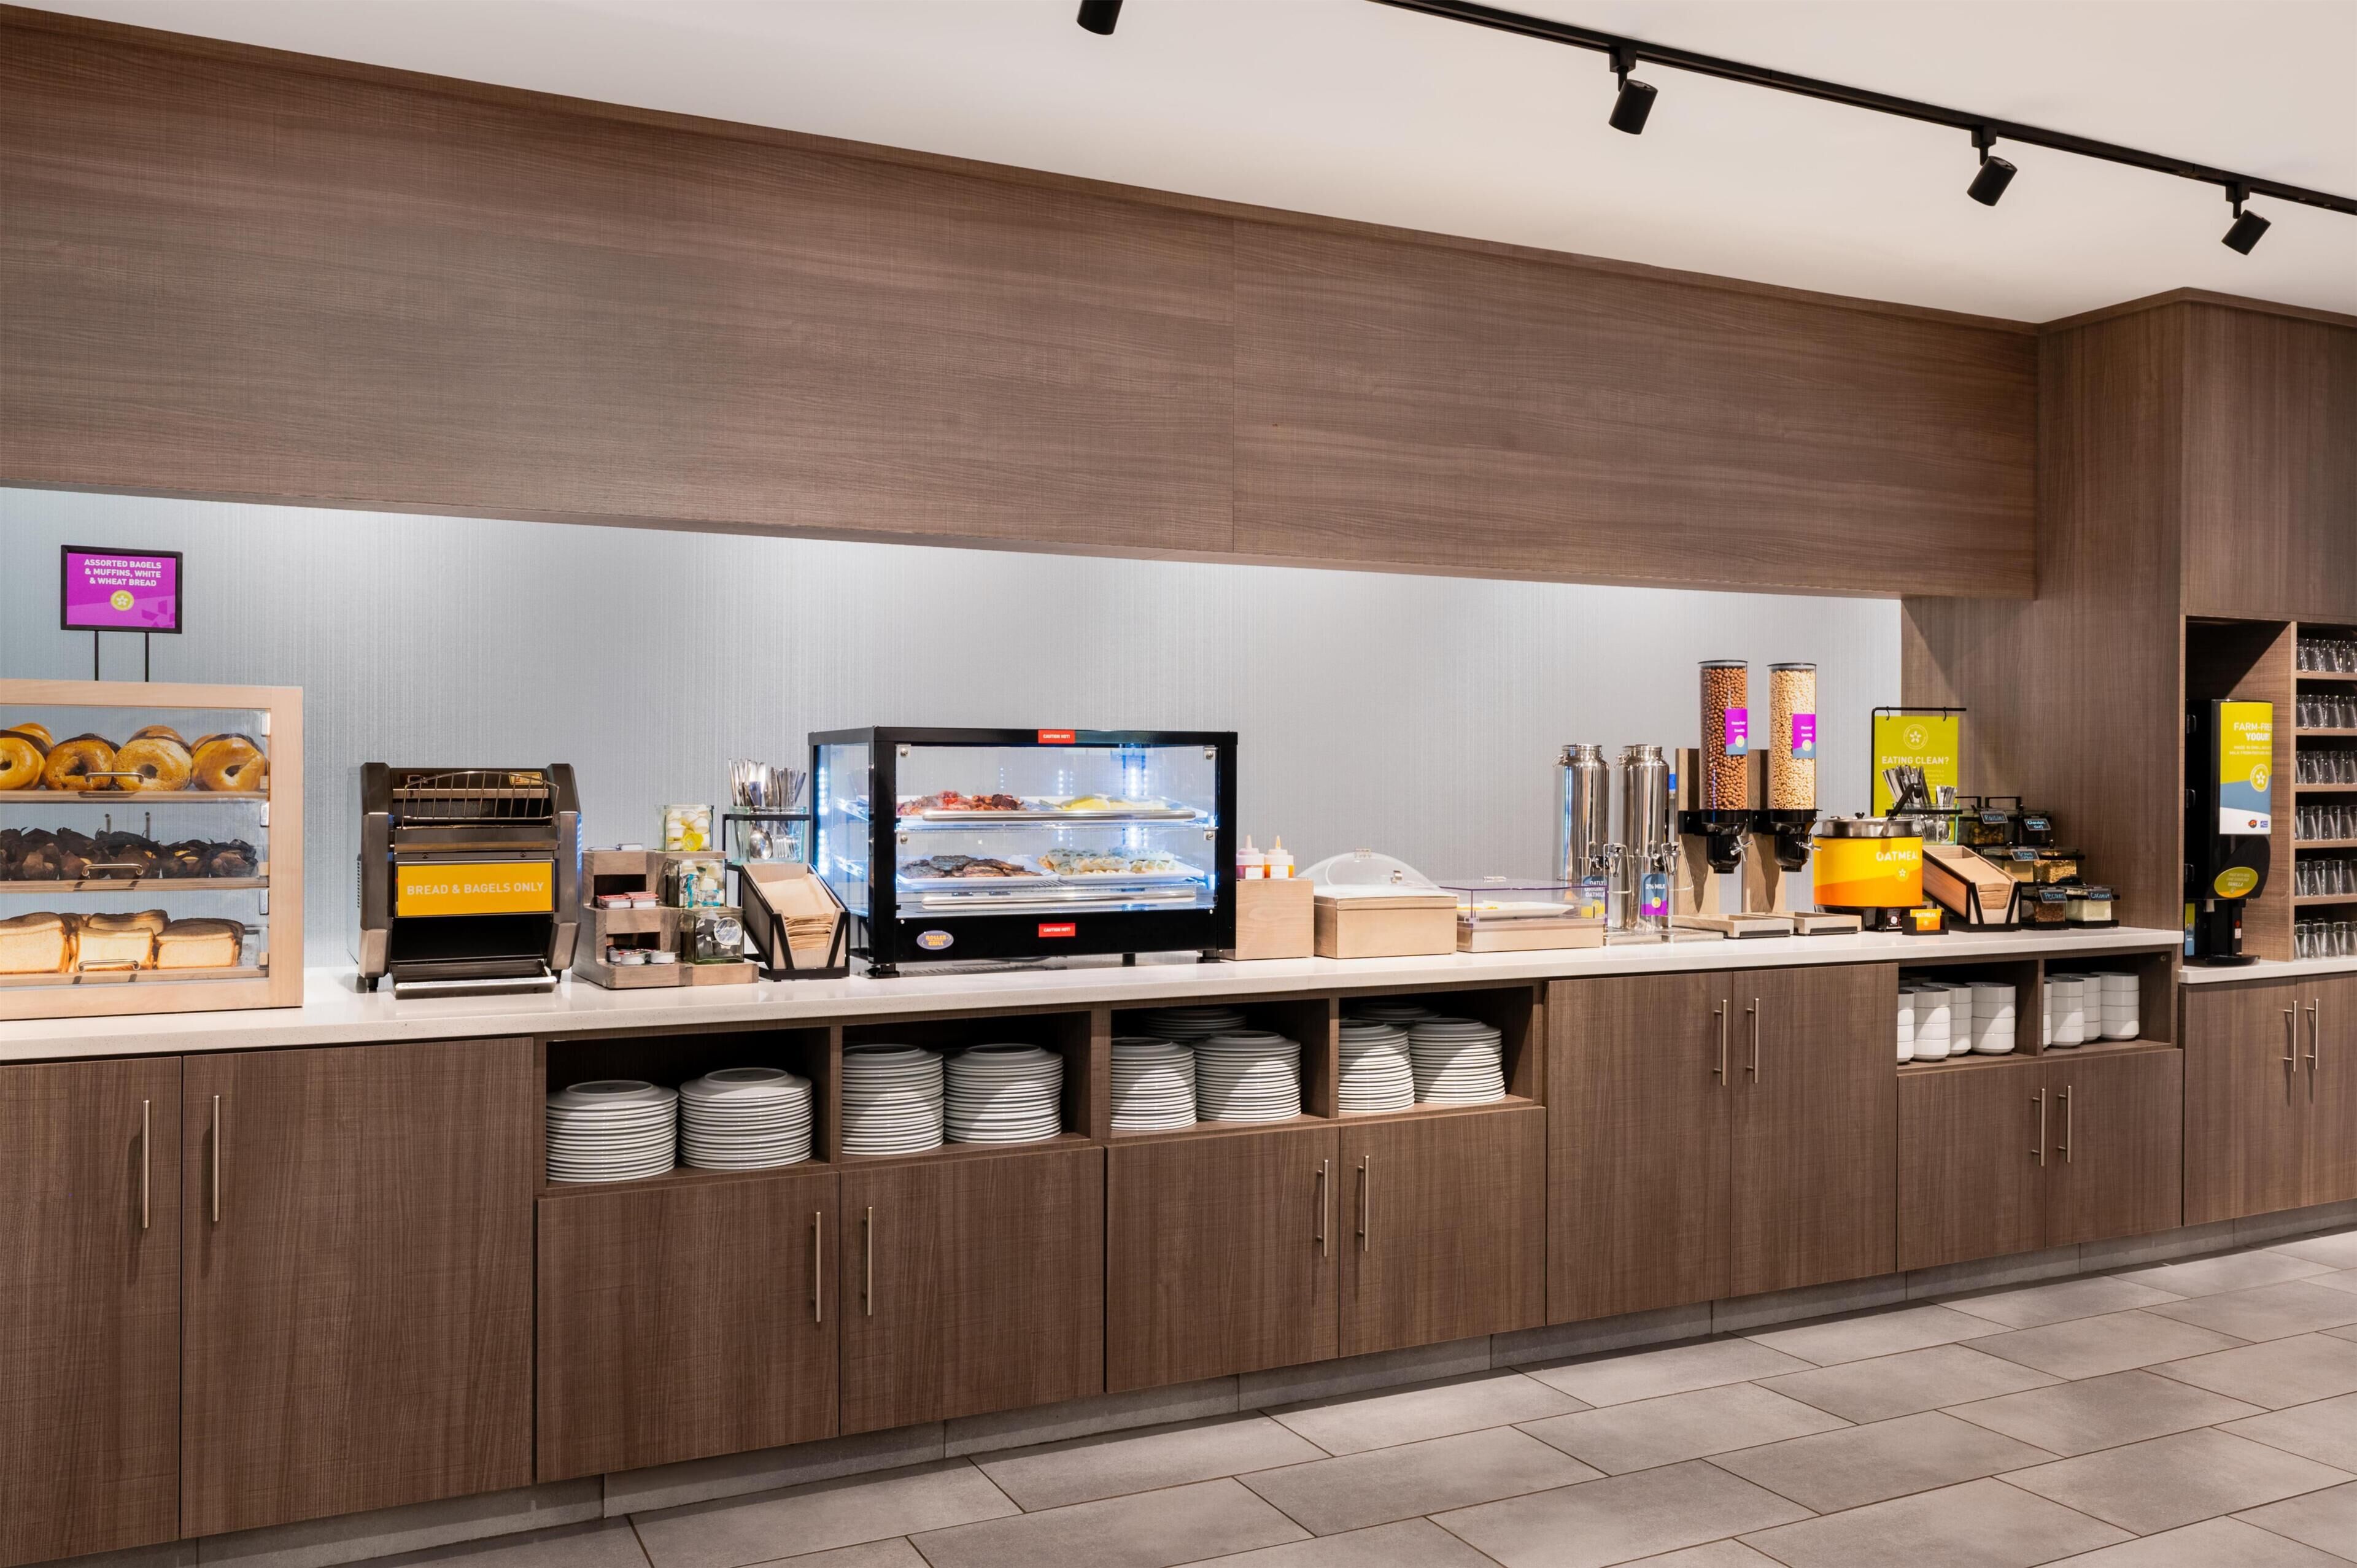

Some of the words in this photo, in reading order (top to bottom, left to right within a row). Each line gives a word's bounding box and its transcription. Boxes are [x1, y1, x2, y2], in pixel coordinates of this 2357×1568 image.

[93, 568, 133, 577] MUFFINS,
[2246, 733, 2270, 741] YOGURT
[1915, 756, 1949, 765] CLEAN?
[1876, 851, 1919, 862] OATMEAL
[407, 884, 448, 895] BREAD
[452, 884, 460, 894] &
[464, 882, 511, 894] BAGELS
[514, 882, 544, 892] ONLY
